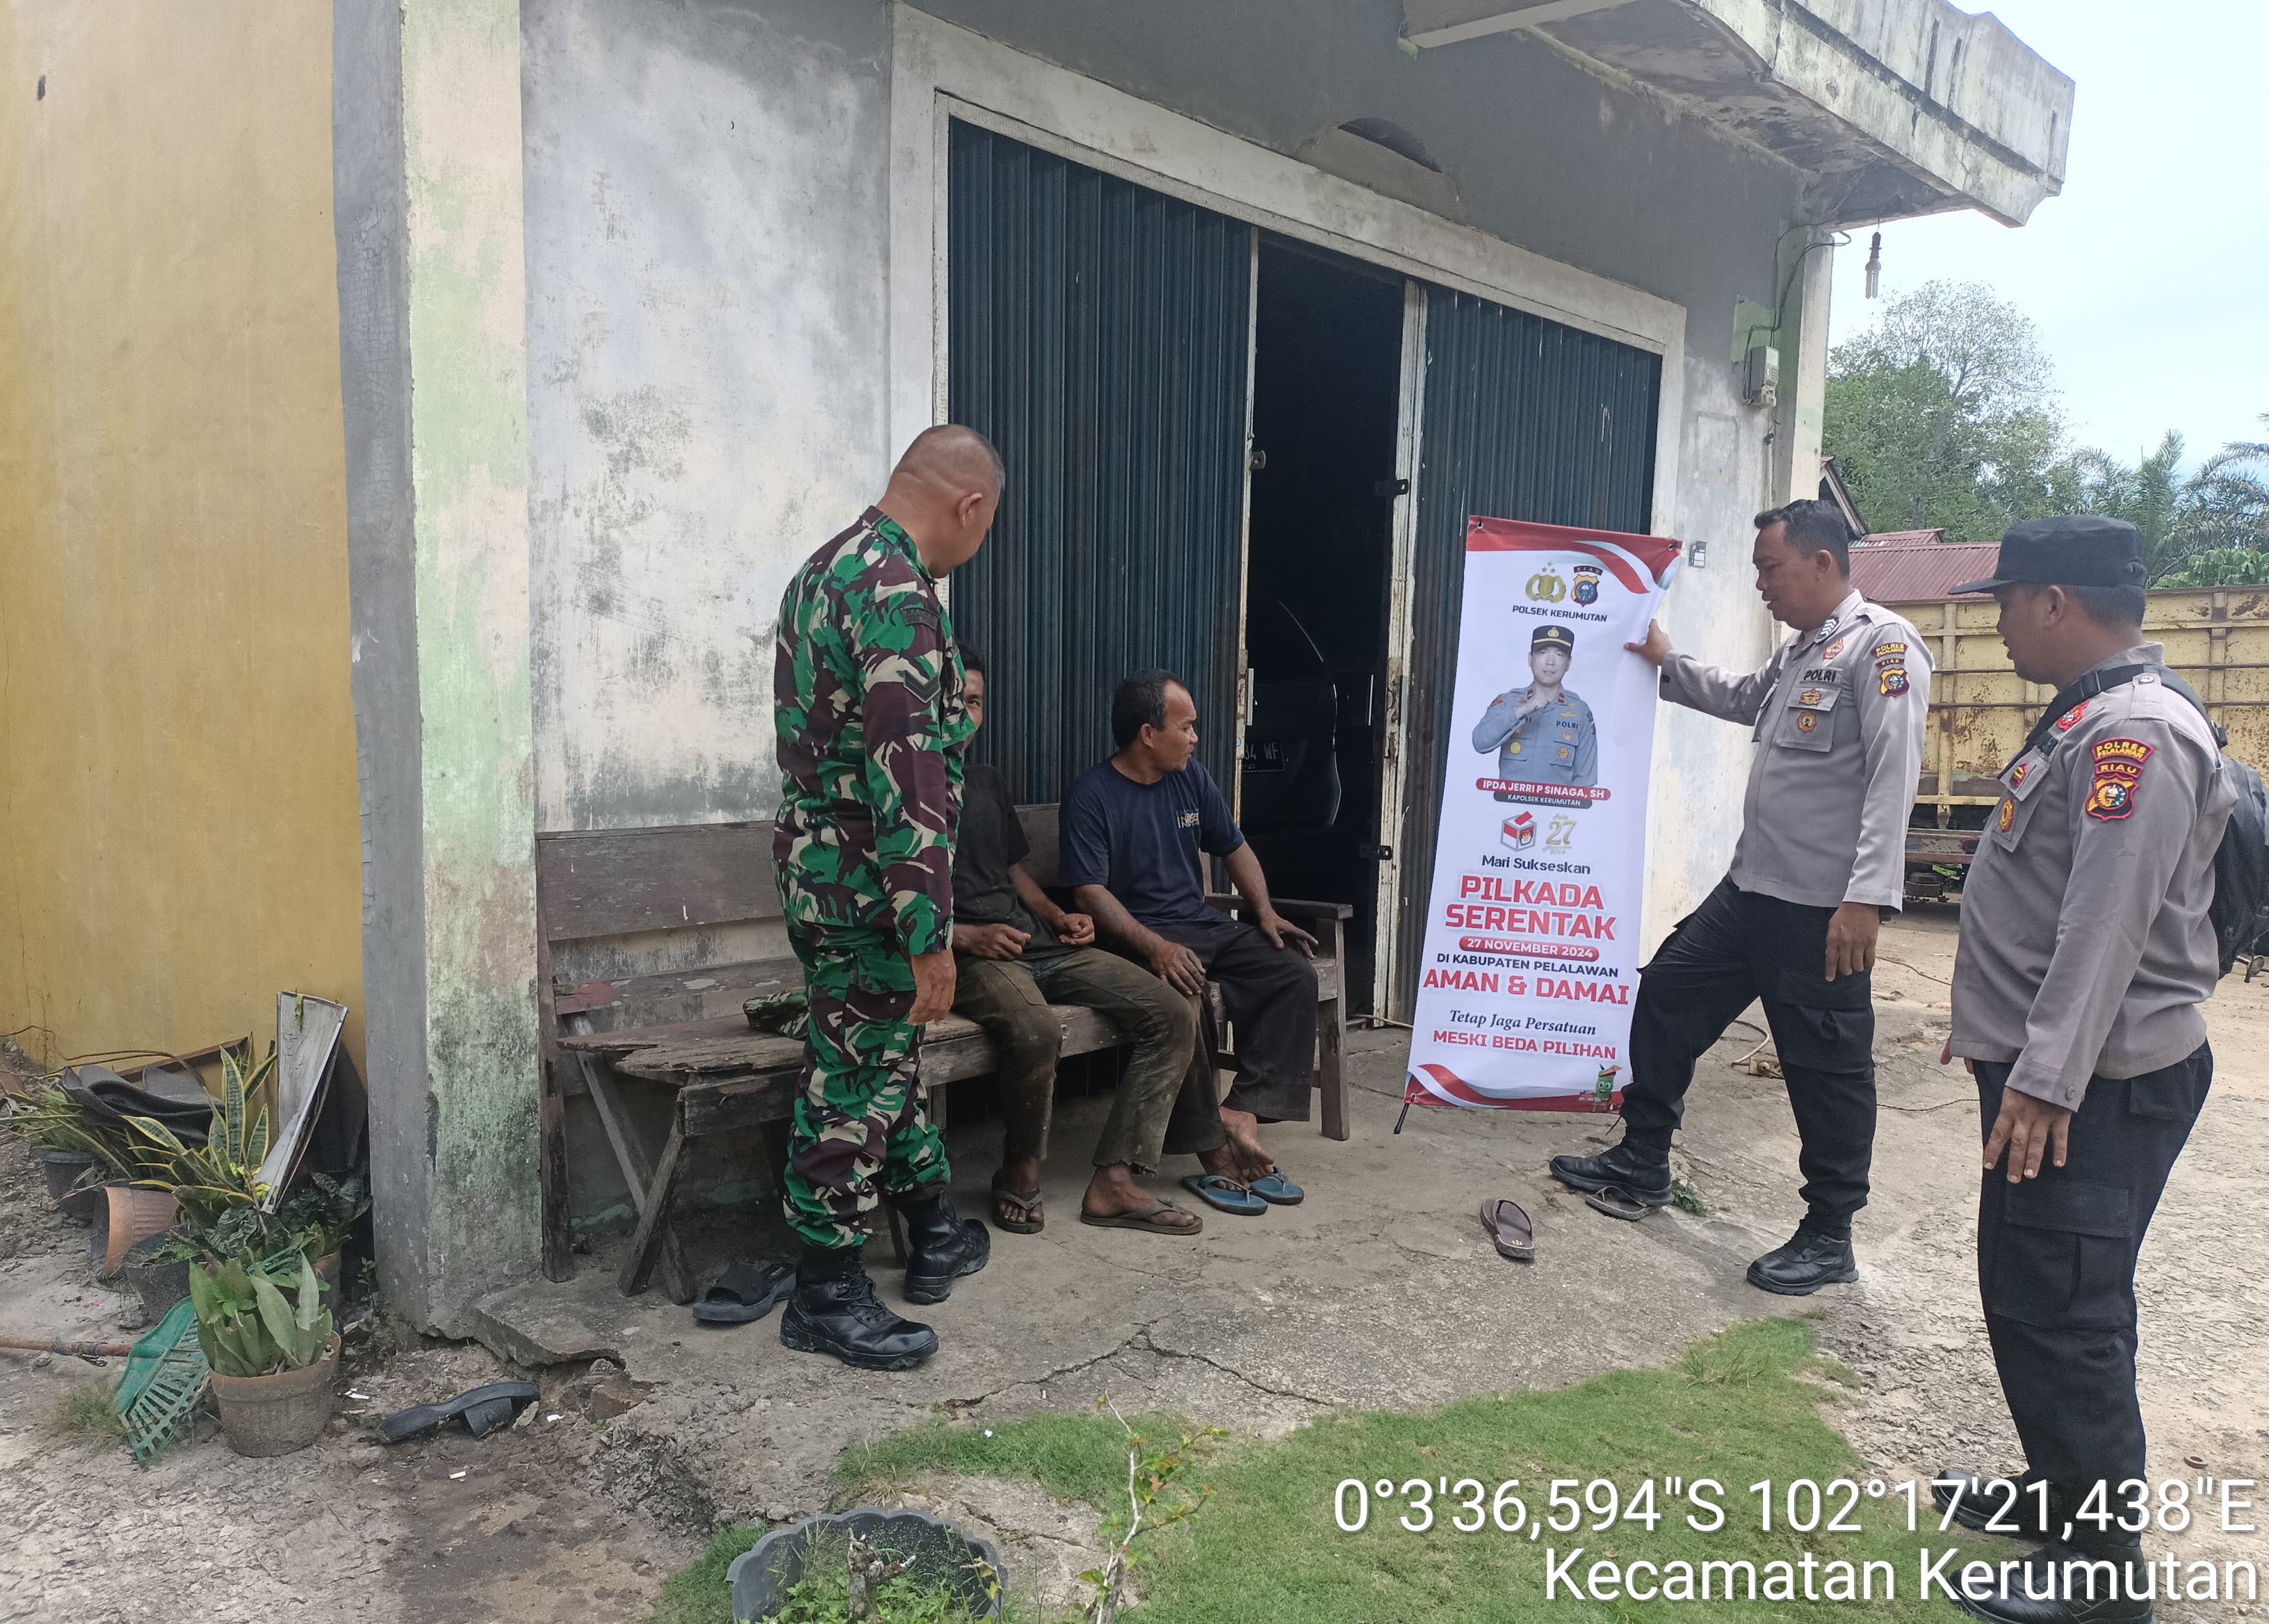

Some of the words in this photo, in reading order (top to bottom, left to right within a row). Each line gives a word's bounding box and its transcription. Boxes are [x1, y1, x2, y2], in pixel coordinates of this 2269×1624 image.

[1513, 605, 1548, 616] POLSEK
[1550, 609, 1607, 622] KERUMUTAN
[1804, 669, 1837, 682] POLRI
[1556, 721, 1579, 729] POLRI
[2096, 741, 2147, 754] POLRES
[2097, 748, 2143, 759] PELALAWAN
[2101, 764, 2137, 774] RIAU
[1483, 779, 1506, 790] IPDA
[1508, 782, 1535, 793] JERRI
[1545, 786, 1587, 798] SINAGA,
[1590, 790, 1604, 798] SH
[1507, 794, 1539, 802] KAPOLSEK
[1540, 797, 1581, 806] KERUMUTAN
[1545, 820, 1577, 845] 27
[1482, 854, 1510, 868] Mari
[1513, 857, 1591, 875] Sukseskan
[1460, 875, 1604, 910] PILKADA
[1445, 904, 1617, 941] SERENTAK
[1467, 939, 1481, 948] 27
[1484, 940, 1558, 955] NOVEMBER
[1561, 947, 1593, 959] 2024
[1437, 953, 1449, 964] DI
[1452, 955, 1530, 970] KABUPATEN
[1534, 961, 1618, 977] PELALAWAN
[1424, 968, 1499, 993] AMAN
[1508, 975, 1527, 996] &
[1536, 977, 1629, 1005] DAMAI
[1449, 1009, 1487, 1028] Tetap
[1490, 1014, 1521, 1030] Jaga
[1525, 1017, 1596, 1036] Persatuan
[1433, 1030, 1487, 1047] MESKI
[1493, 1034, 1538, 1052] BEDA
[1543, 1040, 1616, 1060] PILIHAN
